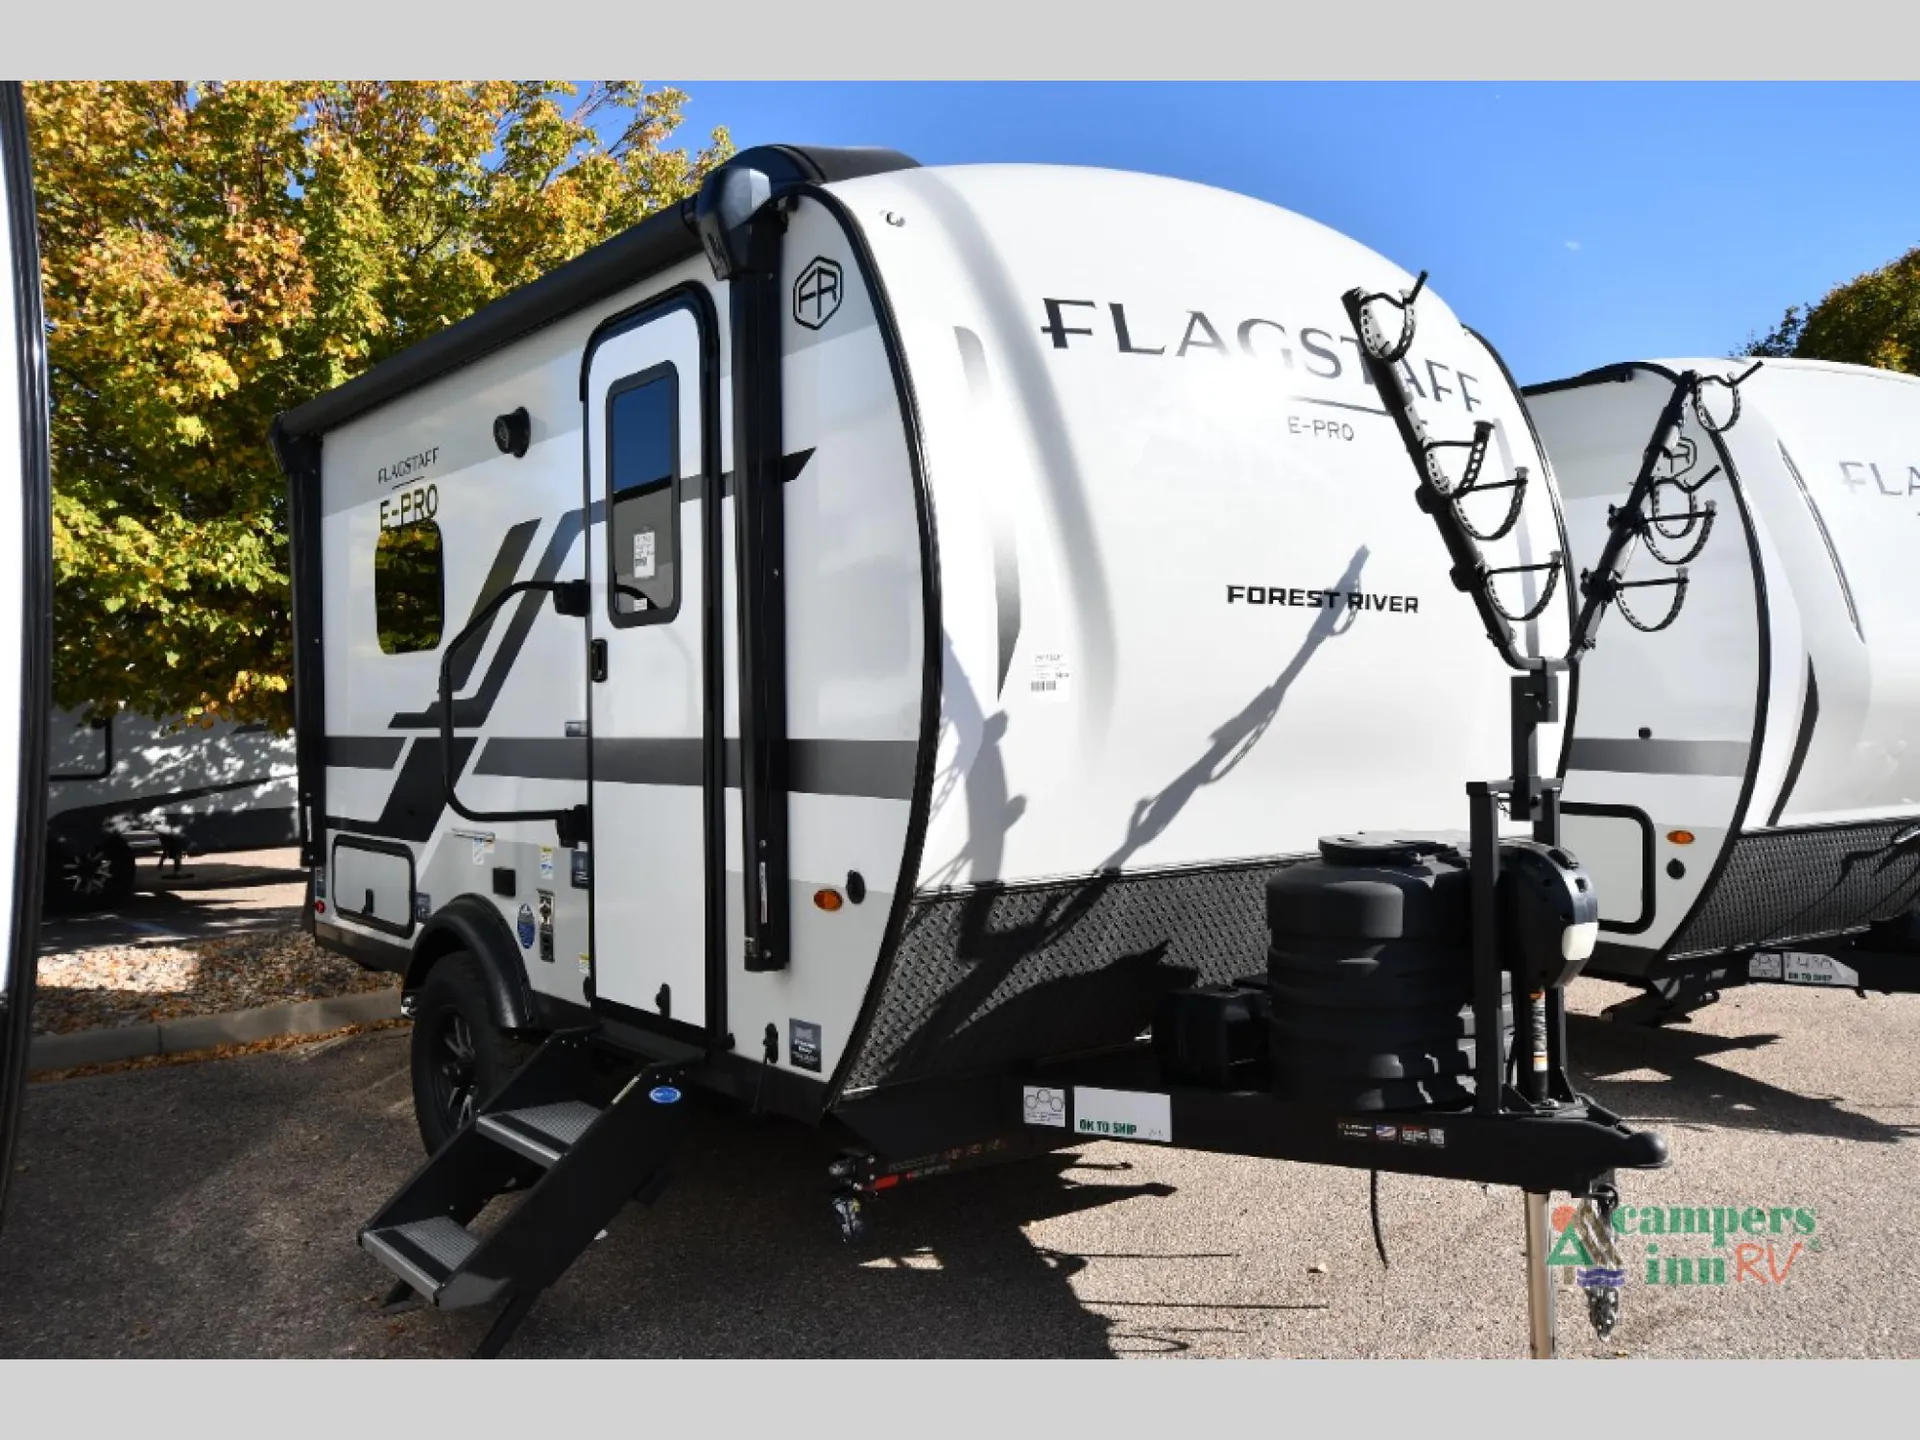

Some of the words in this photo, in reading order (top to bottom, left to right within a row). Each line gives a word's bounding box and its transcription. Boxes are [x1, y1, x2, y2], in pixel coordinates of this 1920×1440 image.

[1288, 416, 1355, 441] E-PRO
[377, 446, 440, 484] FLAGSTAFF
[380, 484, 438, 532] E-PRO
[1226, 585, 1340, 609] FOREST
[1347, 592, 1419, 613] RIVER
[1079, 1118, 1094, 1132] OK
[1096, 1120, 1110, 1133] TO
[1113, 1122, 1137, 1135] SHIP
